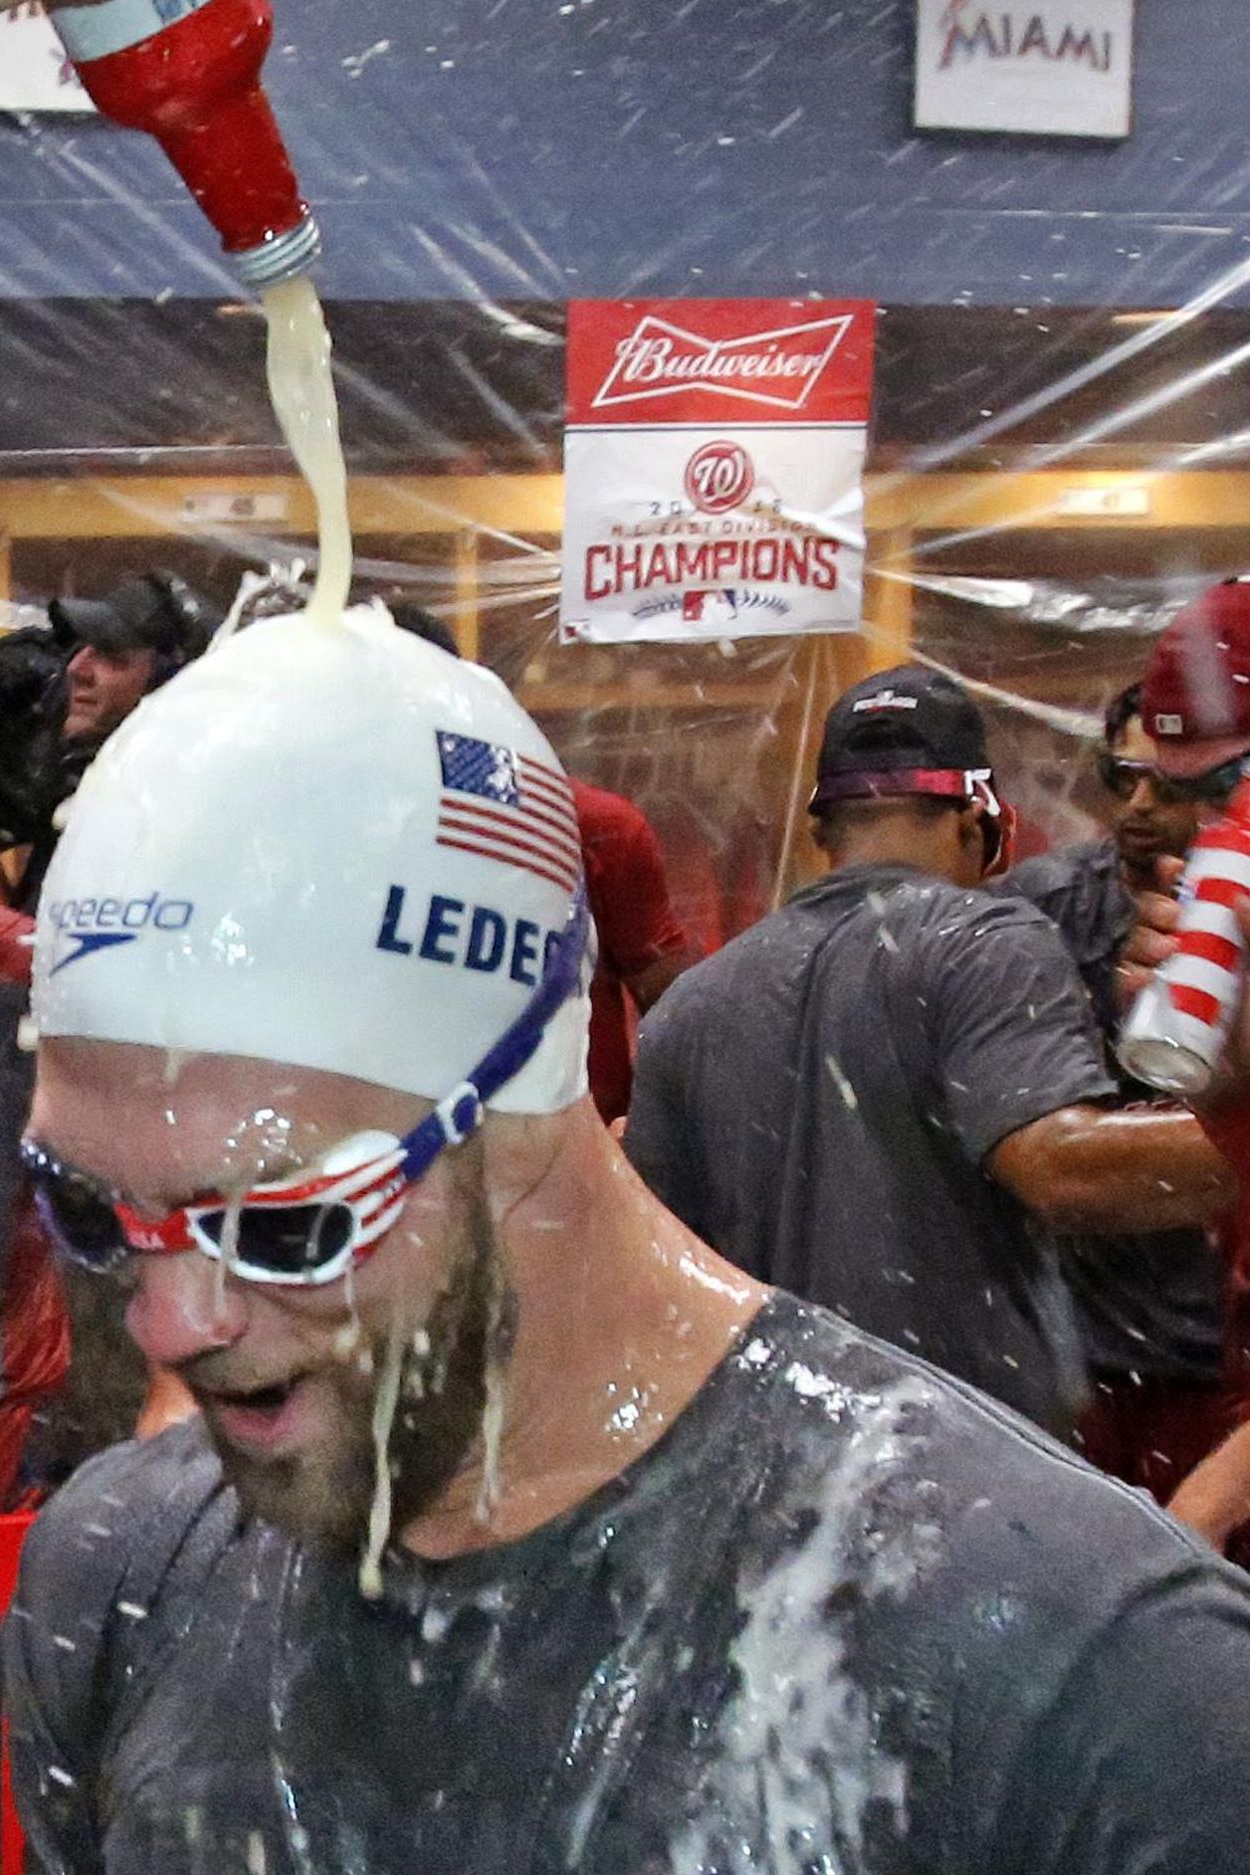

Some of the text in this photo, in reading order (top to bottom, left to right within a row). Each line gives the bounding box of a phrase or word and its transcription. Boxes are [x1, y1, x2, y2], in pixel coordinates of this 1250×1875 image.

[937, 13, 1111, 70] MIAMI
[616, 337, 823, 383] Budweiser
[584, 536, 840, 601] CHAMPIONS
[49, 891, 194, 936] speedo
